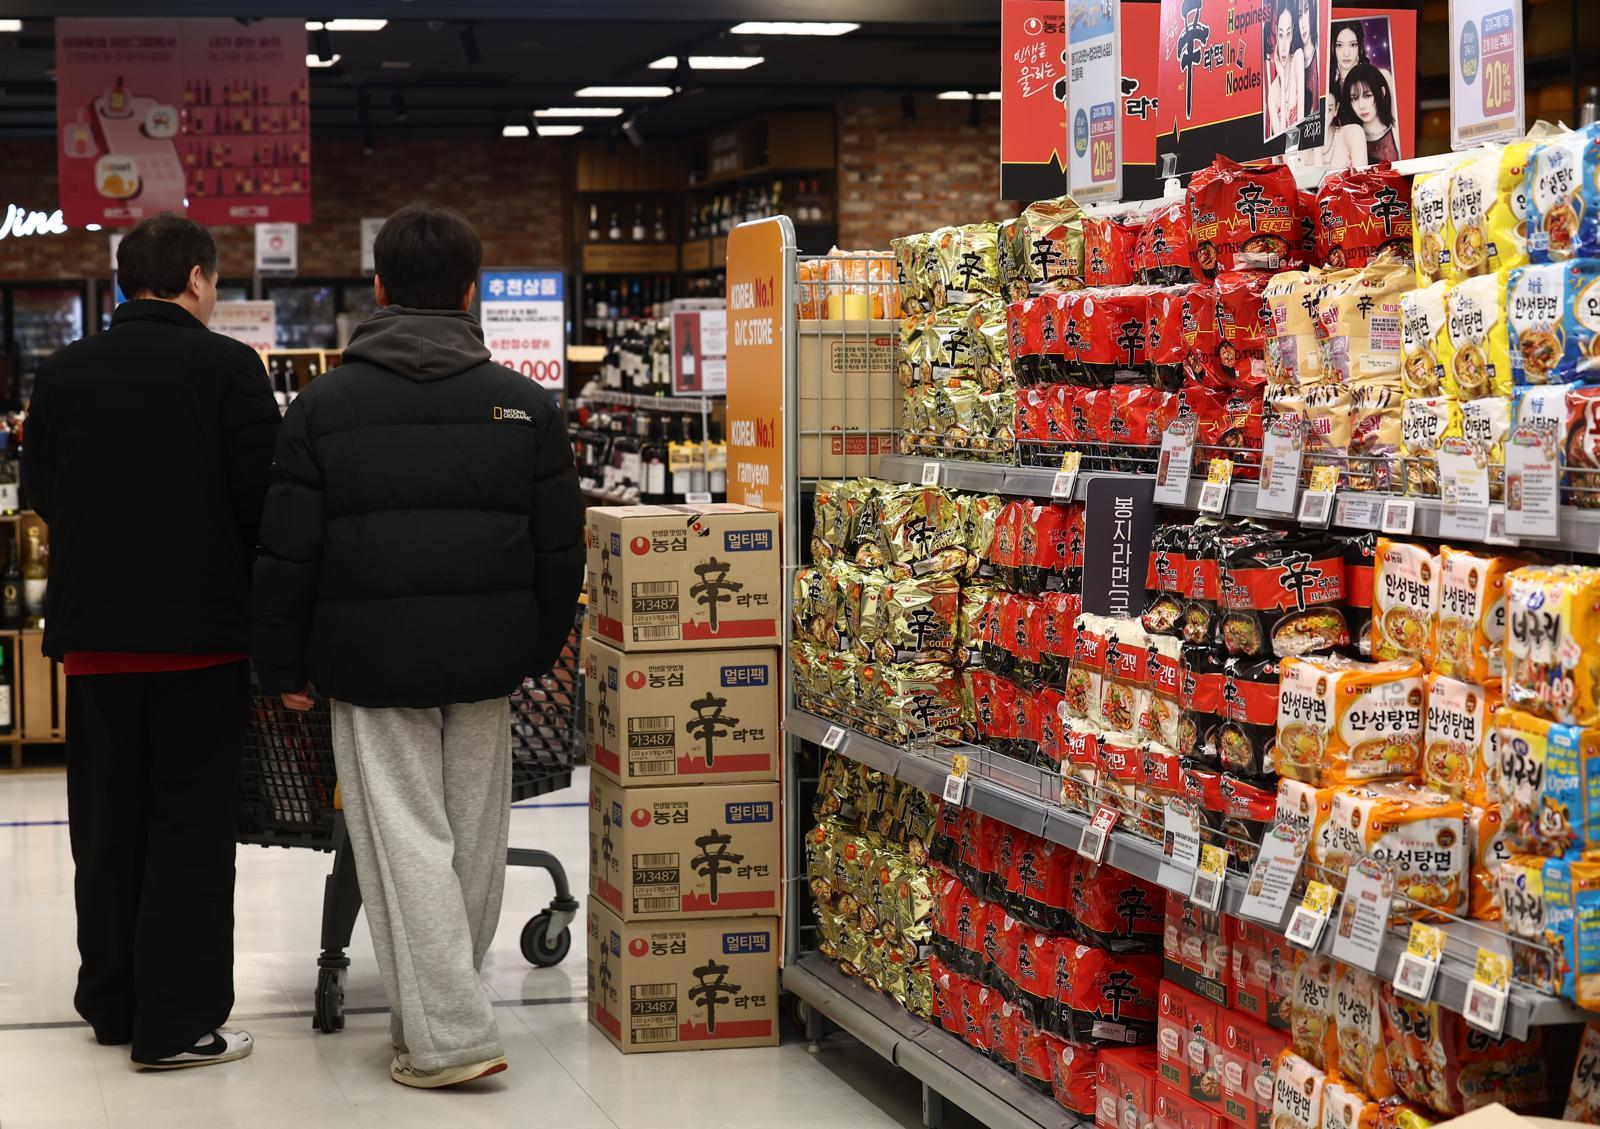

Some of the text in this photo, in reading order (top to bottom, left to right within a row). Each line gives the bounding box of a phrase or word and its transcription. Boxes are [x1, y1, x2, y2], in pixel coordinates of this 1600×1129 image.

[1228, 4, 1272, 34] Happiness
[1203, 42, 1224, 73] 라면
[1227, 41, 1236, 66] In
[1226, 70, 1261, 97] Noodles
[1486, 60, 1511, 108] 20%
[1093, 140, 1113, 176] 20%
[1235, 182, 1272, 234] 辛
[1267, 206, 1290, 217] 라면
[1371, 186, 1409, 236] 辛
[0, 204, 67, 240] ine
[1259, 219, 1292, 232] 더레드
[956, 251, 985, 292] 辛
[1030, 236, 1062, 283] 辛
[1055, 268, 1079, 276] GOLD
[731, 276, 774, 310] KOREA No.1
[1357, 294, 1375, 320] 辛
[1515, 296, 1558, 319] 안성탕면
[749, 318, 773, 345] STORE
[1117, 317, 1146, 369] 辛
[503, 408, 527, 416] NATIONAL
[731, 417, 774, 448] KOREA No.1
[1403, 416, 1438, 440] 안성탕면
[737, 461, 769, 486] ramyeon
[652, 537, 687, 553] 농심
[728, 533, 768, 549] 멀티팩
[908, 515, 937, 558] 辛
[1279, 551, 1323, 612] 辛
[1317, 576, 1340, 588] 라면
[1385, 573, 1430, 609] 안성탕면
[635, 599, 676, 611] 가3487
[689, 556, 744, 634] 辛
[736, 593, 769, 608] 라면
[1309, 590, 1341, 601] BLACK
[907, 606, 940, 651] 辛
[1512, 610, 1560, 645] 너구리
[1083, 639, 1099, 658] 건면
[1121, 653, 1137, 673] 건면
[1160, 665, 1176, 685] 건면
[649, 673, 684, 688] 농심
[724, 668, 765, 684] 멀티팩
[910, 694, 942, 731] 辛
[1281, 691, 1327, 723] 안성탕면
[1349, 708, 1420, 731] 안성탕면
[686, 692, 740, 768] 辛
[732, 728, 765, 743] 라면
[937, 718, 960, 728] GOLD
[1427, 707, 1475, 741] 안성탕면
[631, 734, 672, 746] 가3487
[1106, 753, 1126, 770] 건면
[1154, 762, 1169, 780] 건면
[1501, 752, 1544, 790] 너구리
[1547, 775, 1580, 794] Open
[653, 810, 689, 825] 농심
[729, 805, 770, 820] 멀티팩
[636, 871, 677, 882] 가3487
[690, 828, 745, 905] 辛
[737, 865, 770, 880] 라면
[1116, 885, 1154, 937] 辛
[651, 940, 686, 956] 농심
[726, 935, 766, 951] 멀티팩
[633, 1001, 674, 1012] 가3487
[687, 959, 742, 1035] 辛
[734, 995, 767, 1009] 라면
[1100, 969, 1141, 1021] 辛
[1277, 1081, 1311, 1121] 안성탕면
